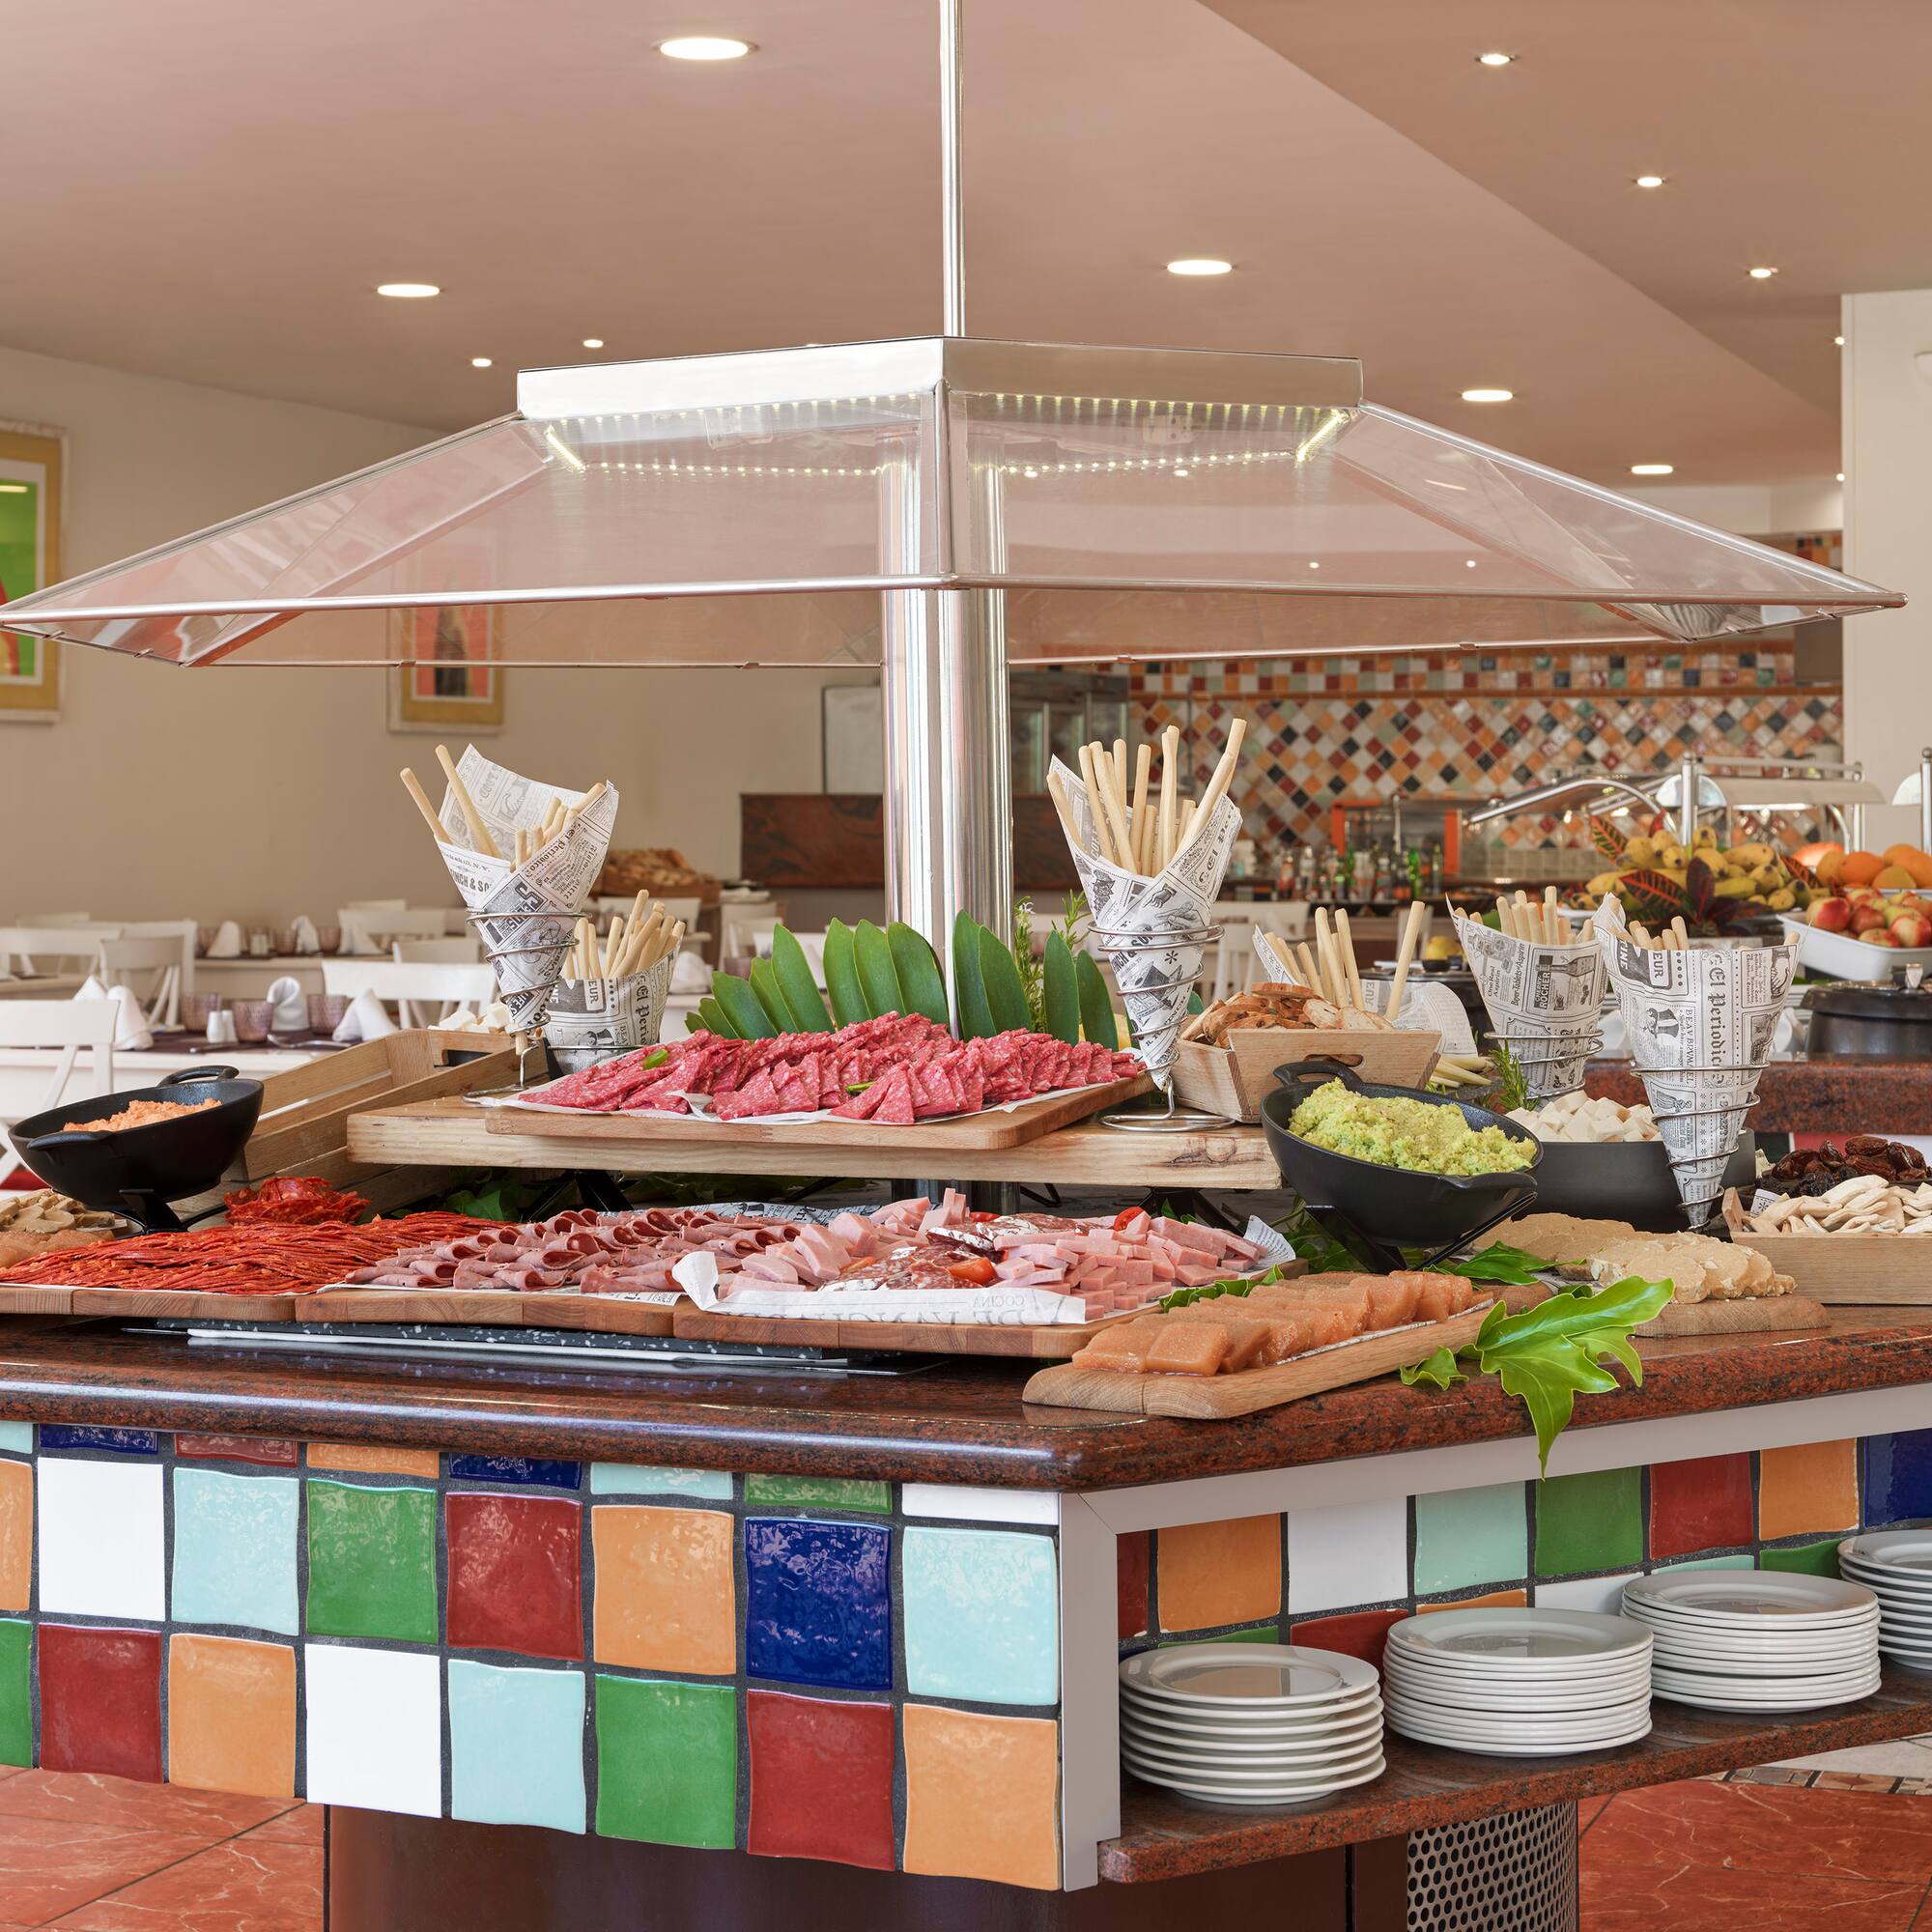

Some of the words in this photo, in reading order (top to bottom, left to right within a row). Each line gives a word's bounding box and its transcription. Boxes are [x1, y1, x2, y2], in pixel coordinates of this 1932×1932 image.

[469, 877, 476, 891] &
[477, 880, 493, 893] SO
[1709, 967, 1726, 986] El
[637, 985, 649, 1002] El
[1540, 972, 1550, 1009] ROCHER
[1707, 993, 1726, 1070] Periodic
